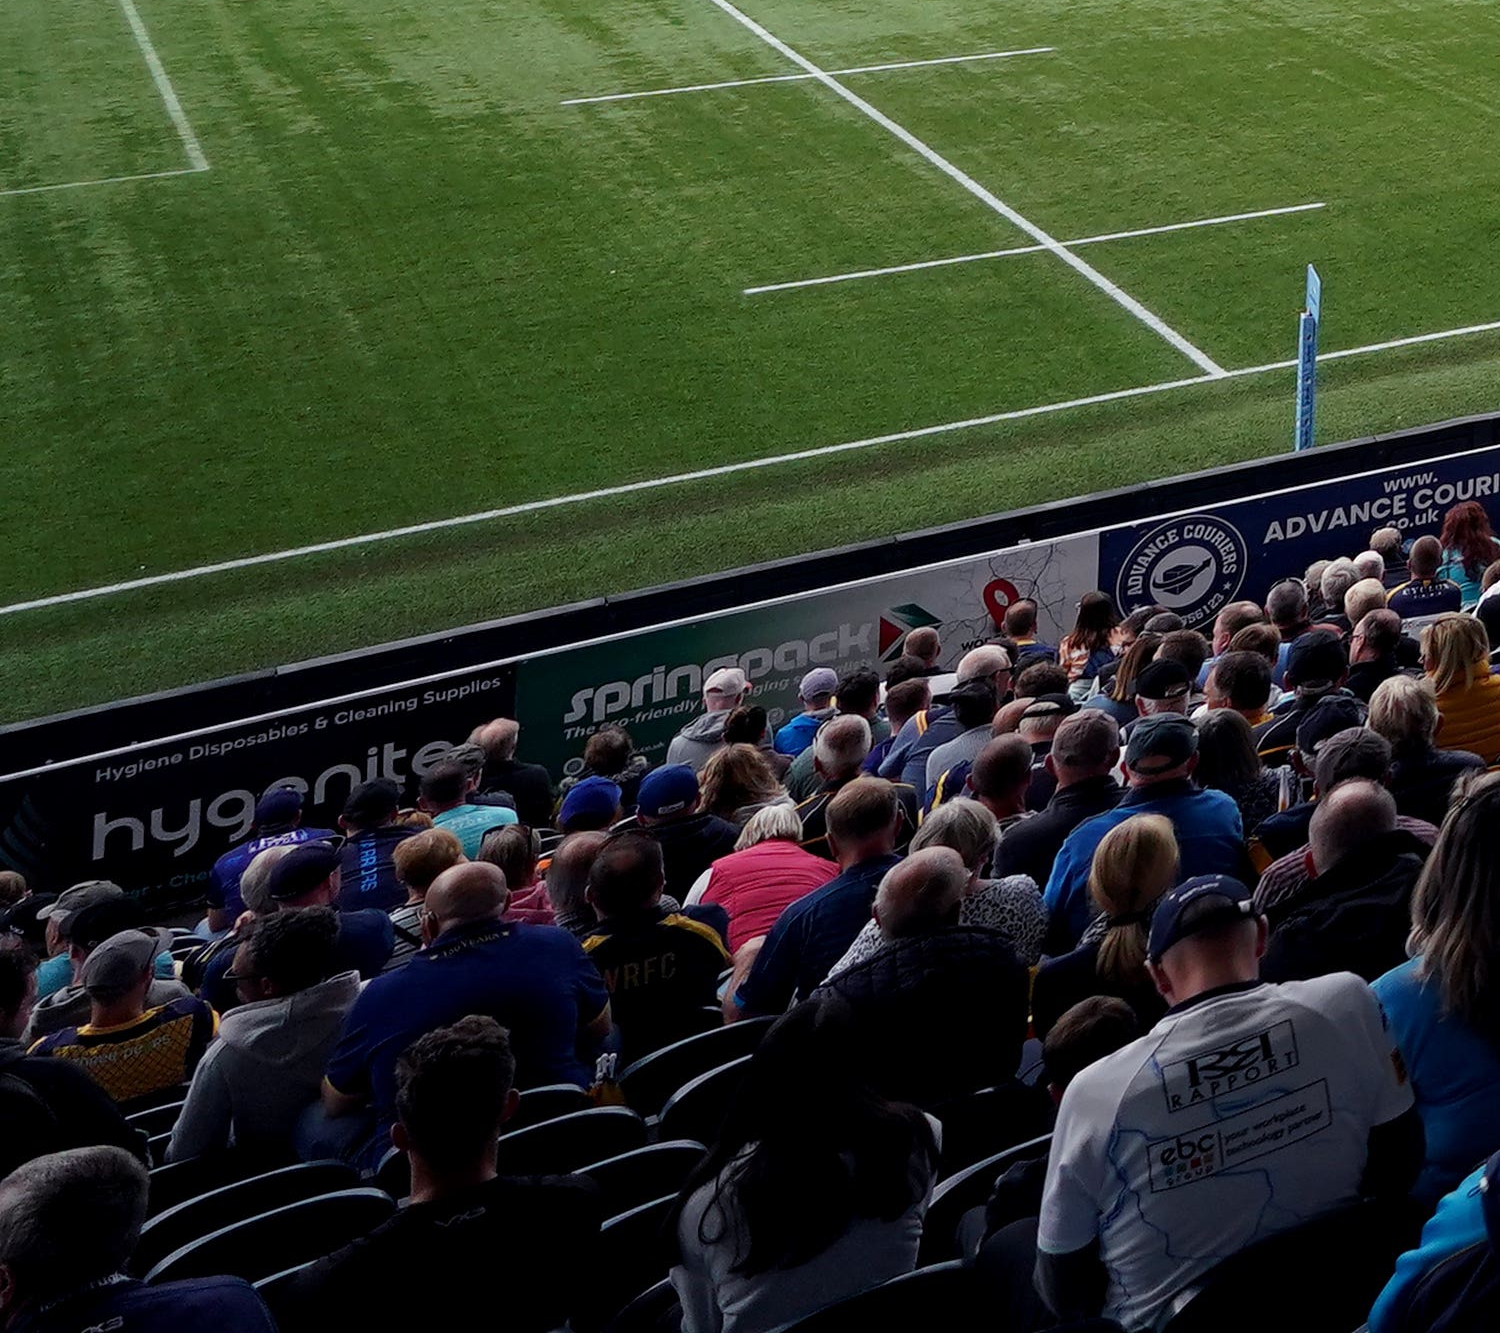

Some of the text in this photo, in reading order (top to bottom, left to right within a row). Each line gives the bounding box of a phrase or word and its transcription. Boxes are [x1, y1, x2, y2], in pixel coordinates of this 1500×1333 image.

[1384, 471, 1438, 493] www.
[1263, 493, 1408, 544] ADVANCE
[1127, 523, 1238, 596] ADVANCE COURIERS
[95, 676, 502, 783] Hygiene Disposables & Cleaning Supplies
[1172, 1051, 1292, 1108] RAPPORT
[1224, 1103, 1306, 1143] your workplace
[1227, 1128, 1284, 1157] technology
[1161, 1133, 1214, 1165] ebc
